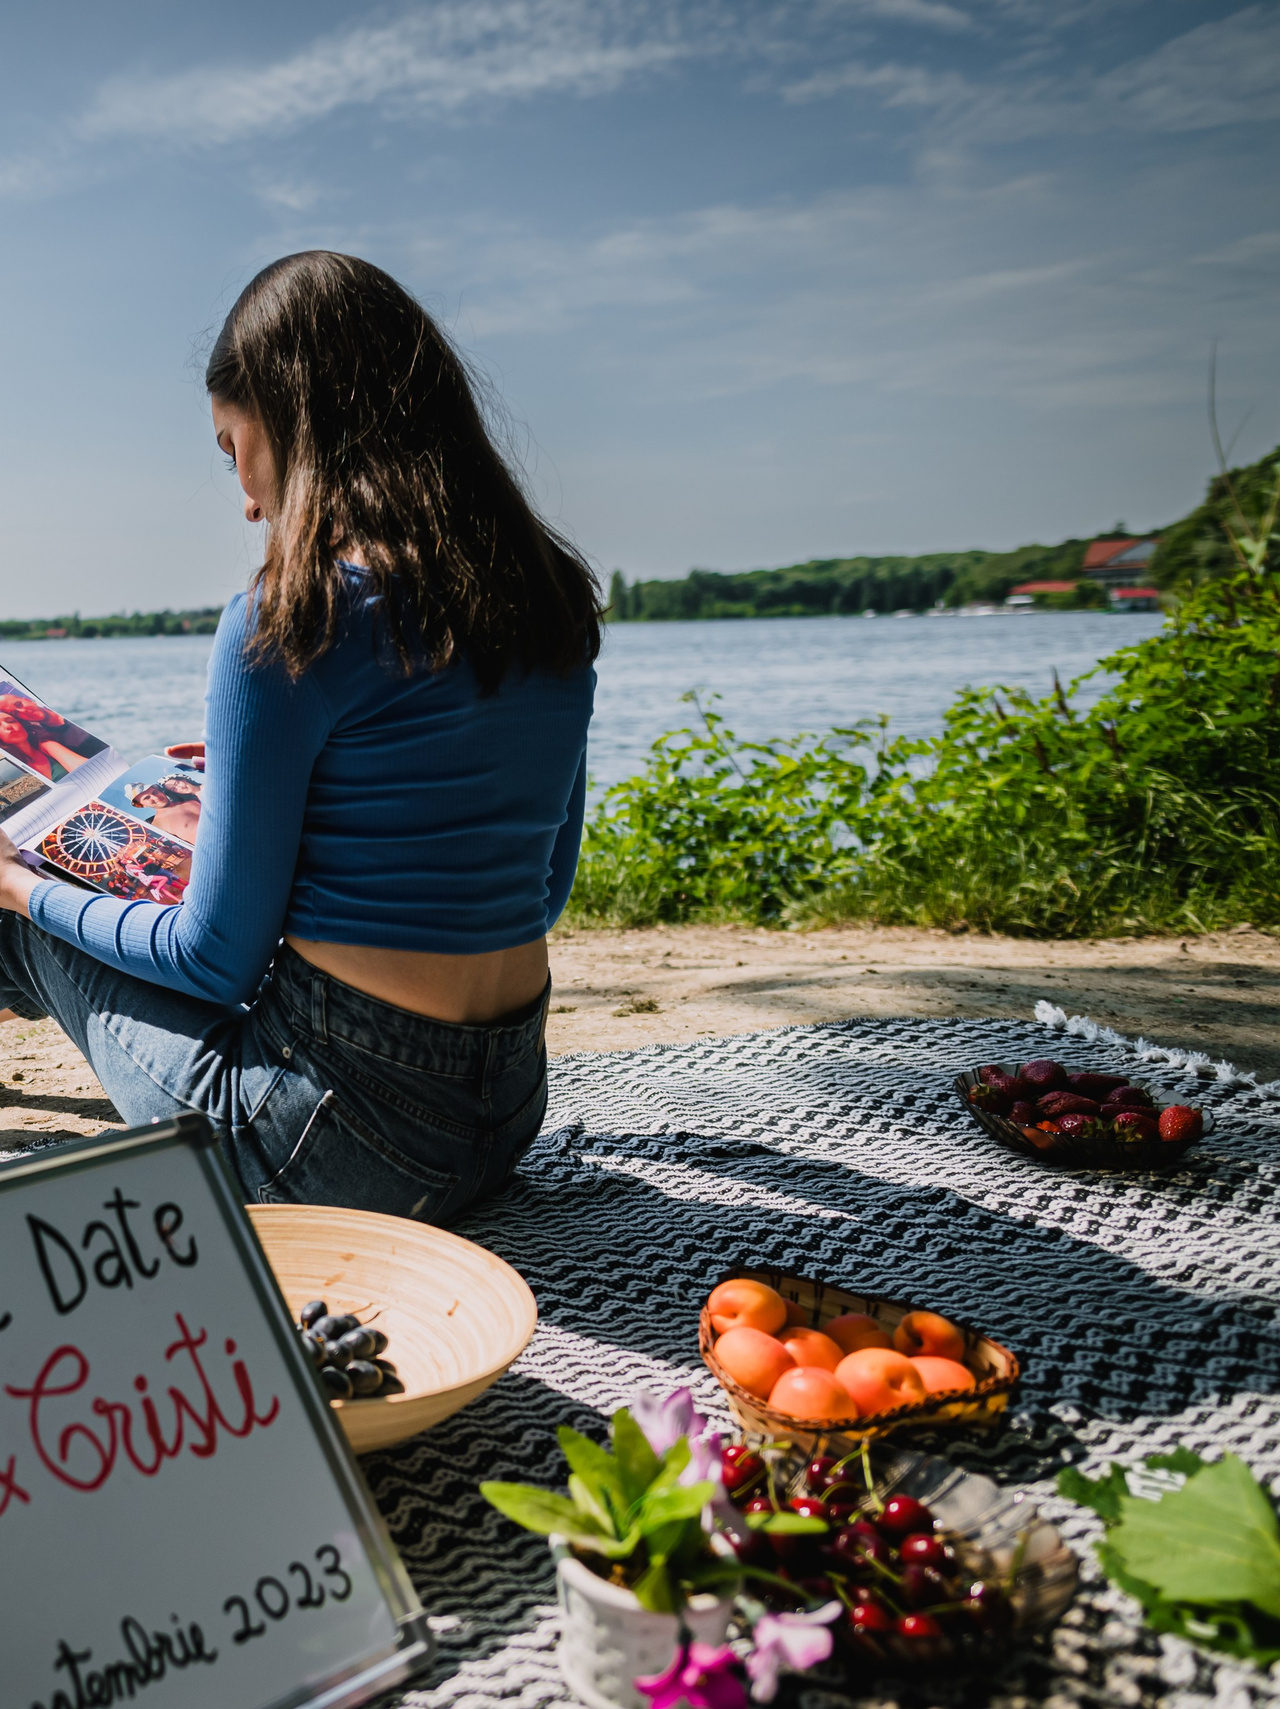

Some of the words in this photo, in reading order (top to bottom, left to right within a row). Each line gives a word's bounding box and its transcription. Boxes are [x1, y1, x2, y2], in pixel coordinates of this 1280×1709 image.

[24, 1186, 200, 1316] Date
[4, 1311, 281, 1493] Cristi
[28, 1612, 219, 1709] tembrie
[222, 1543, 353, 1646] 2023
